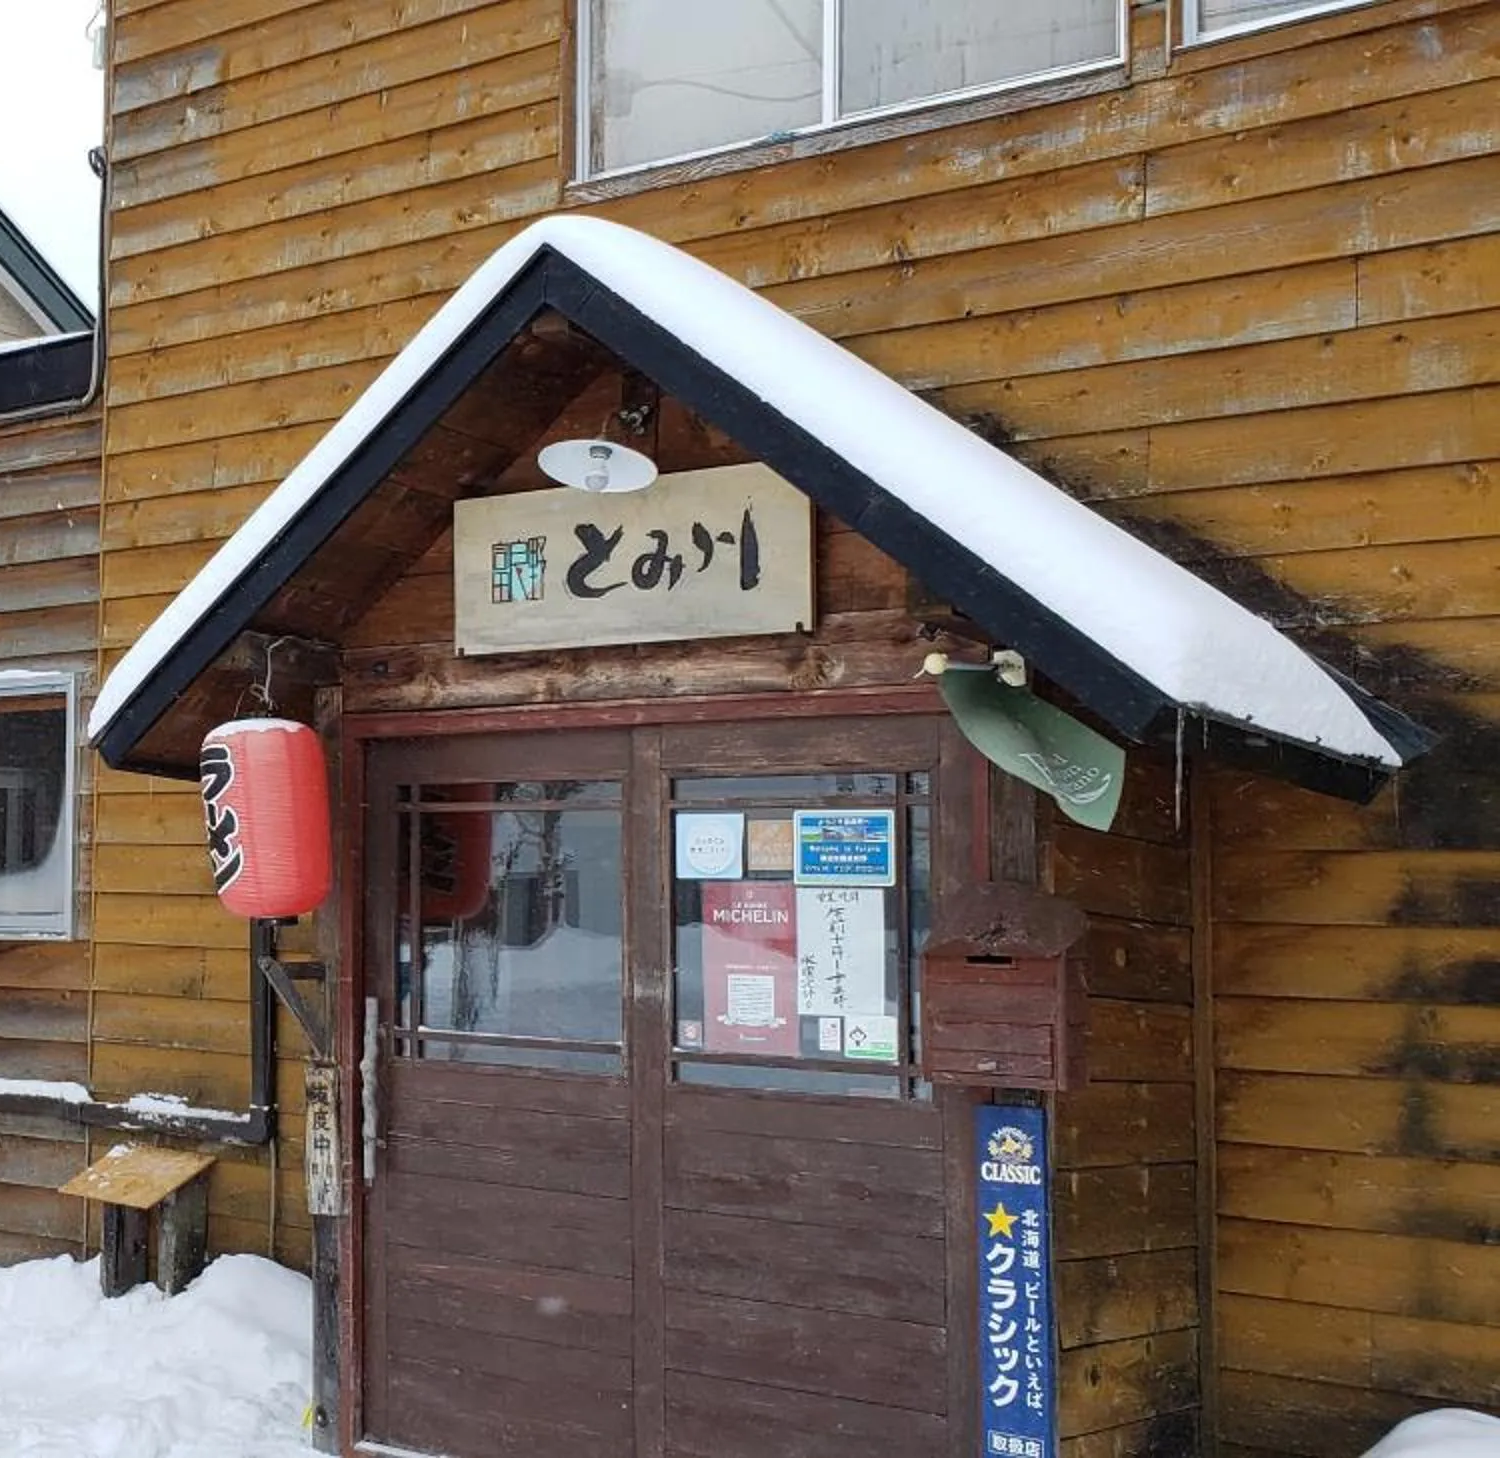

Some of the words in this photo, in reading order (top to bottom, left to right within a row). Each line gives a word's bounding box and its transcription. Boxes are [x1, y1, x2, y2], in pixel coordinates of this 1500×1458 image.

[564, 496, 764, 598] とみ川
[712, 908, 790, 924] MICHELIN
[980, 1161, 1041, 1185] CLASSIC
[985, 1242, 1020, 1408] クラシック
